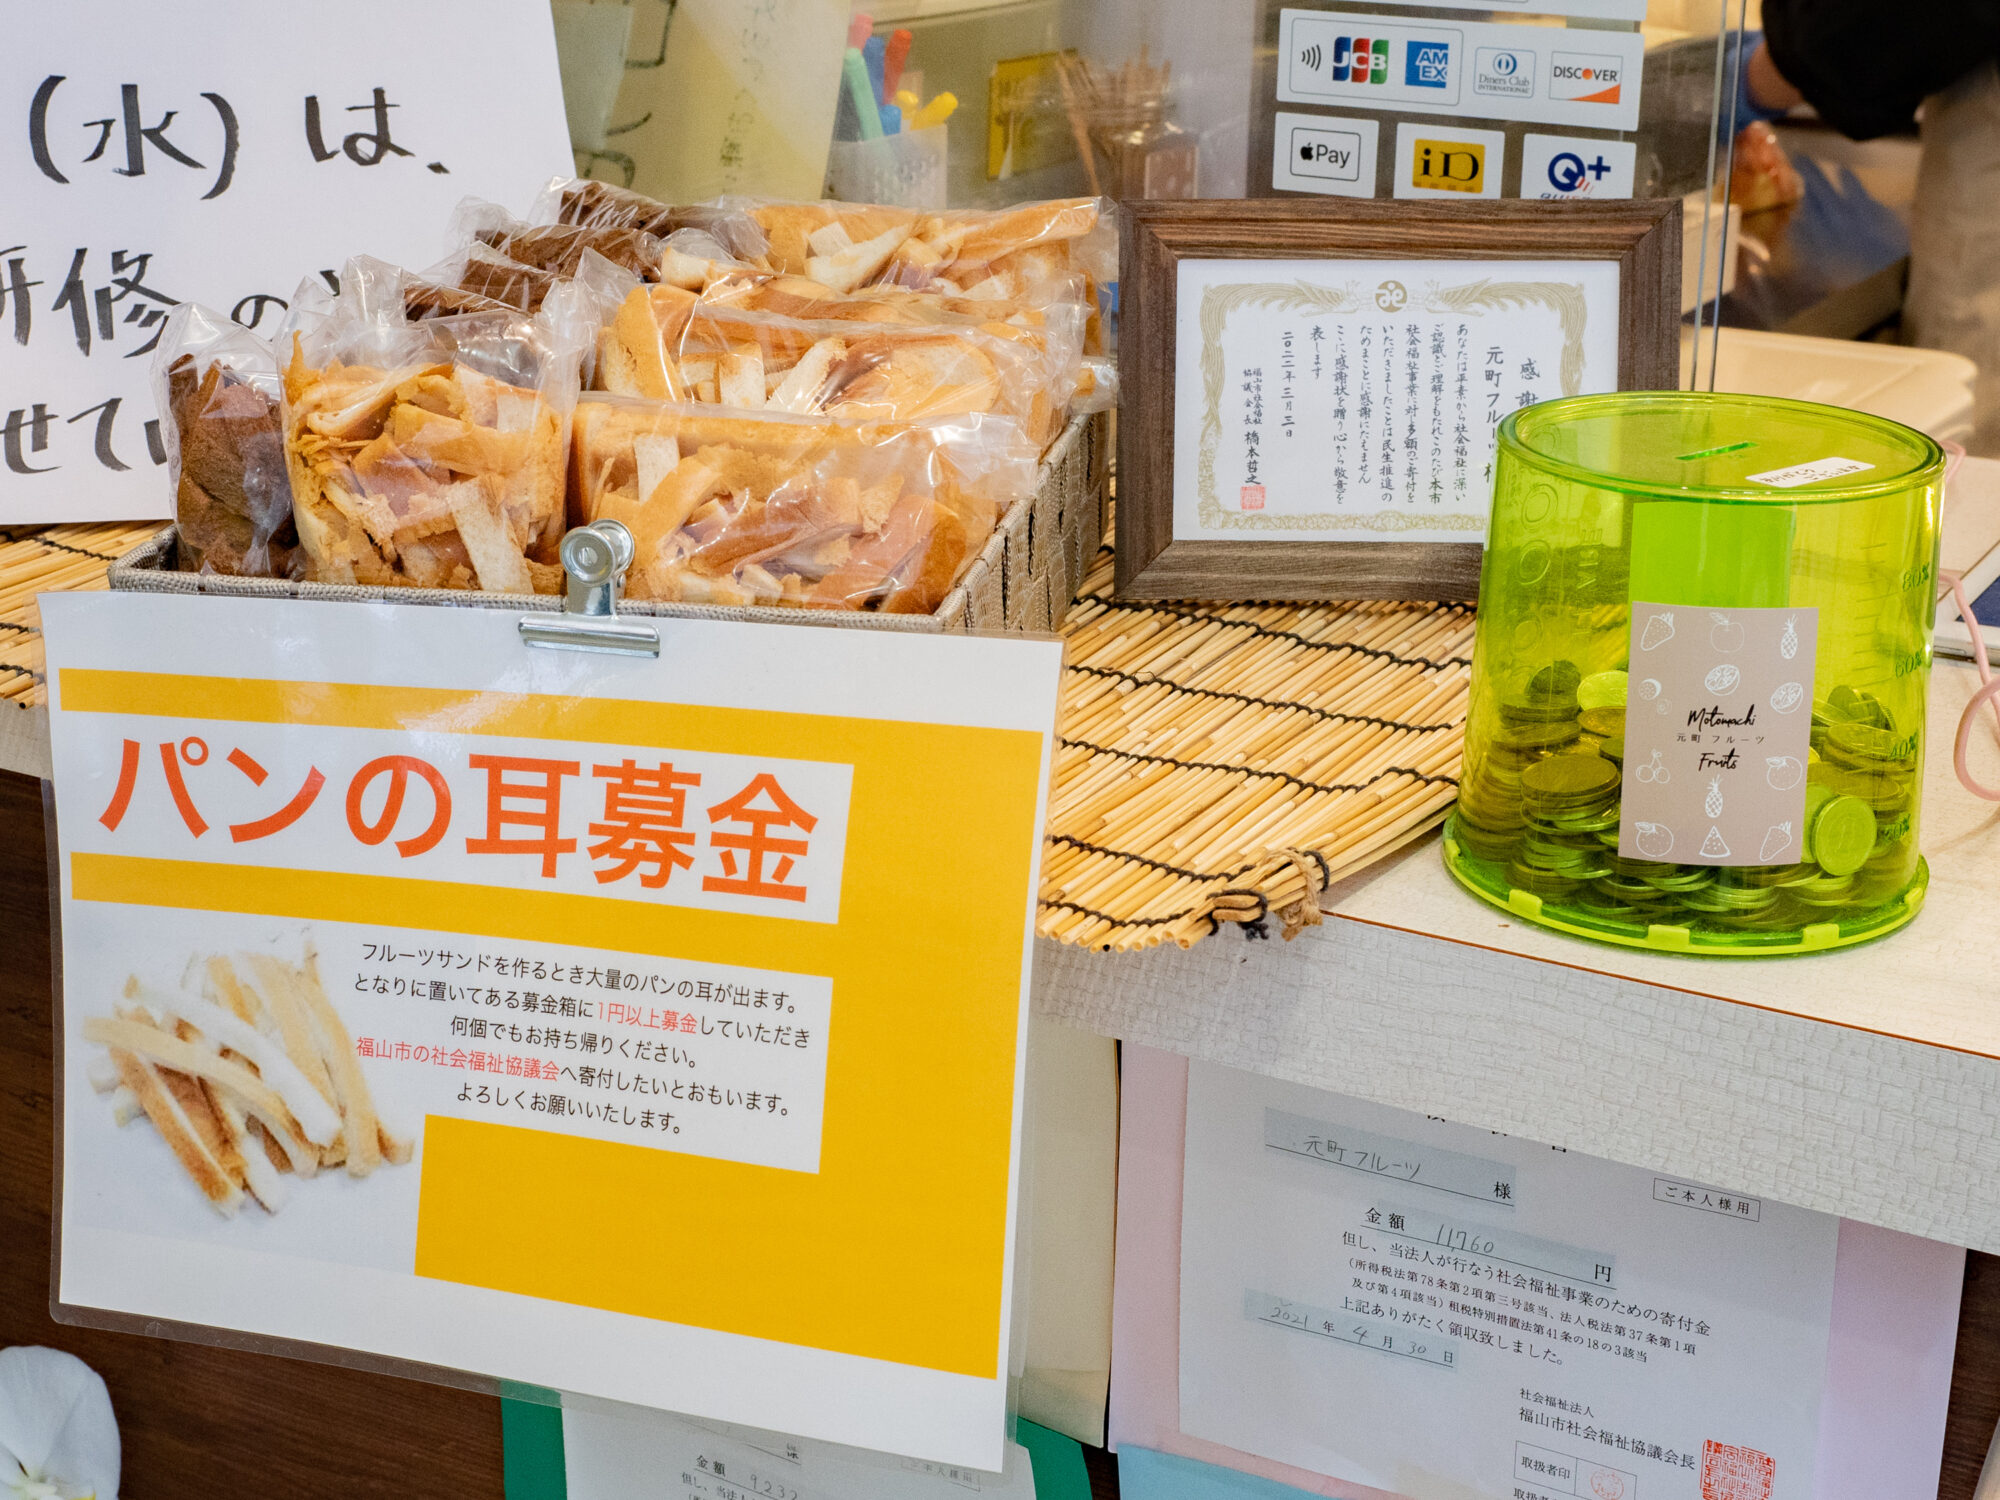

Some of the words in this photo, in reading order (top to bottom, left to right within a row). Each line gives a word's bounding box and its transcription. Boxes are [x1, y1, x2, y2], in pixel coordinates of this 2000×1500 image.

[1415, 48, 1449, 66] AM
[1479, 73, 1507, 86] Diners
[1508, 76, 1530, 87] Club
[1553, 66, 1618, 82] DISCOVER
[1316, 144, 1351, 169] Pay
[1420, 147, 1480, 182] iD
[1310, 324, 1327, 380] 表します
[1686, 703, 1757, 733] Motomachi
[1698, 747, 1741, 773] Fruits
[98, 734, 820, 904] パンの耳募金
[361, 943, 796, 1014] フルーツサンドを作るとき大量のパンの耳が出ます。
[450, 1015, 697, 1069] 何個でもお持ち帰りください。
[456, 1082, 681, 1135] よろしくお願いいたします。
[1493, 1180, 1512, 1200] 様
[1664, 1185, 1750, 1215] ご本人様用
[1364, 1206, 1406, 1232] 金額
[1594, 1263, 1612, 1283] 円
[1339, 1296, 1564, 1367] 上記ありがたく領収致しました。
[1519, 1387, 1595, 1419] 社会福祉法人
[1518, 1406, 1696, 1471] 福山市社会福祉協議会長
[1520, 1455, 1571, 1481] 取扱者印
